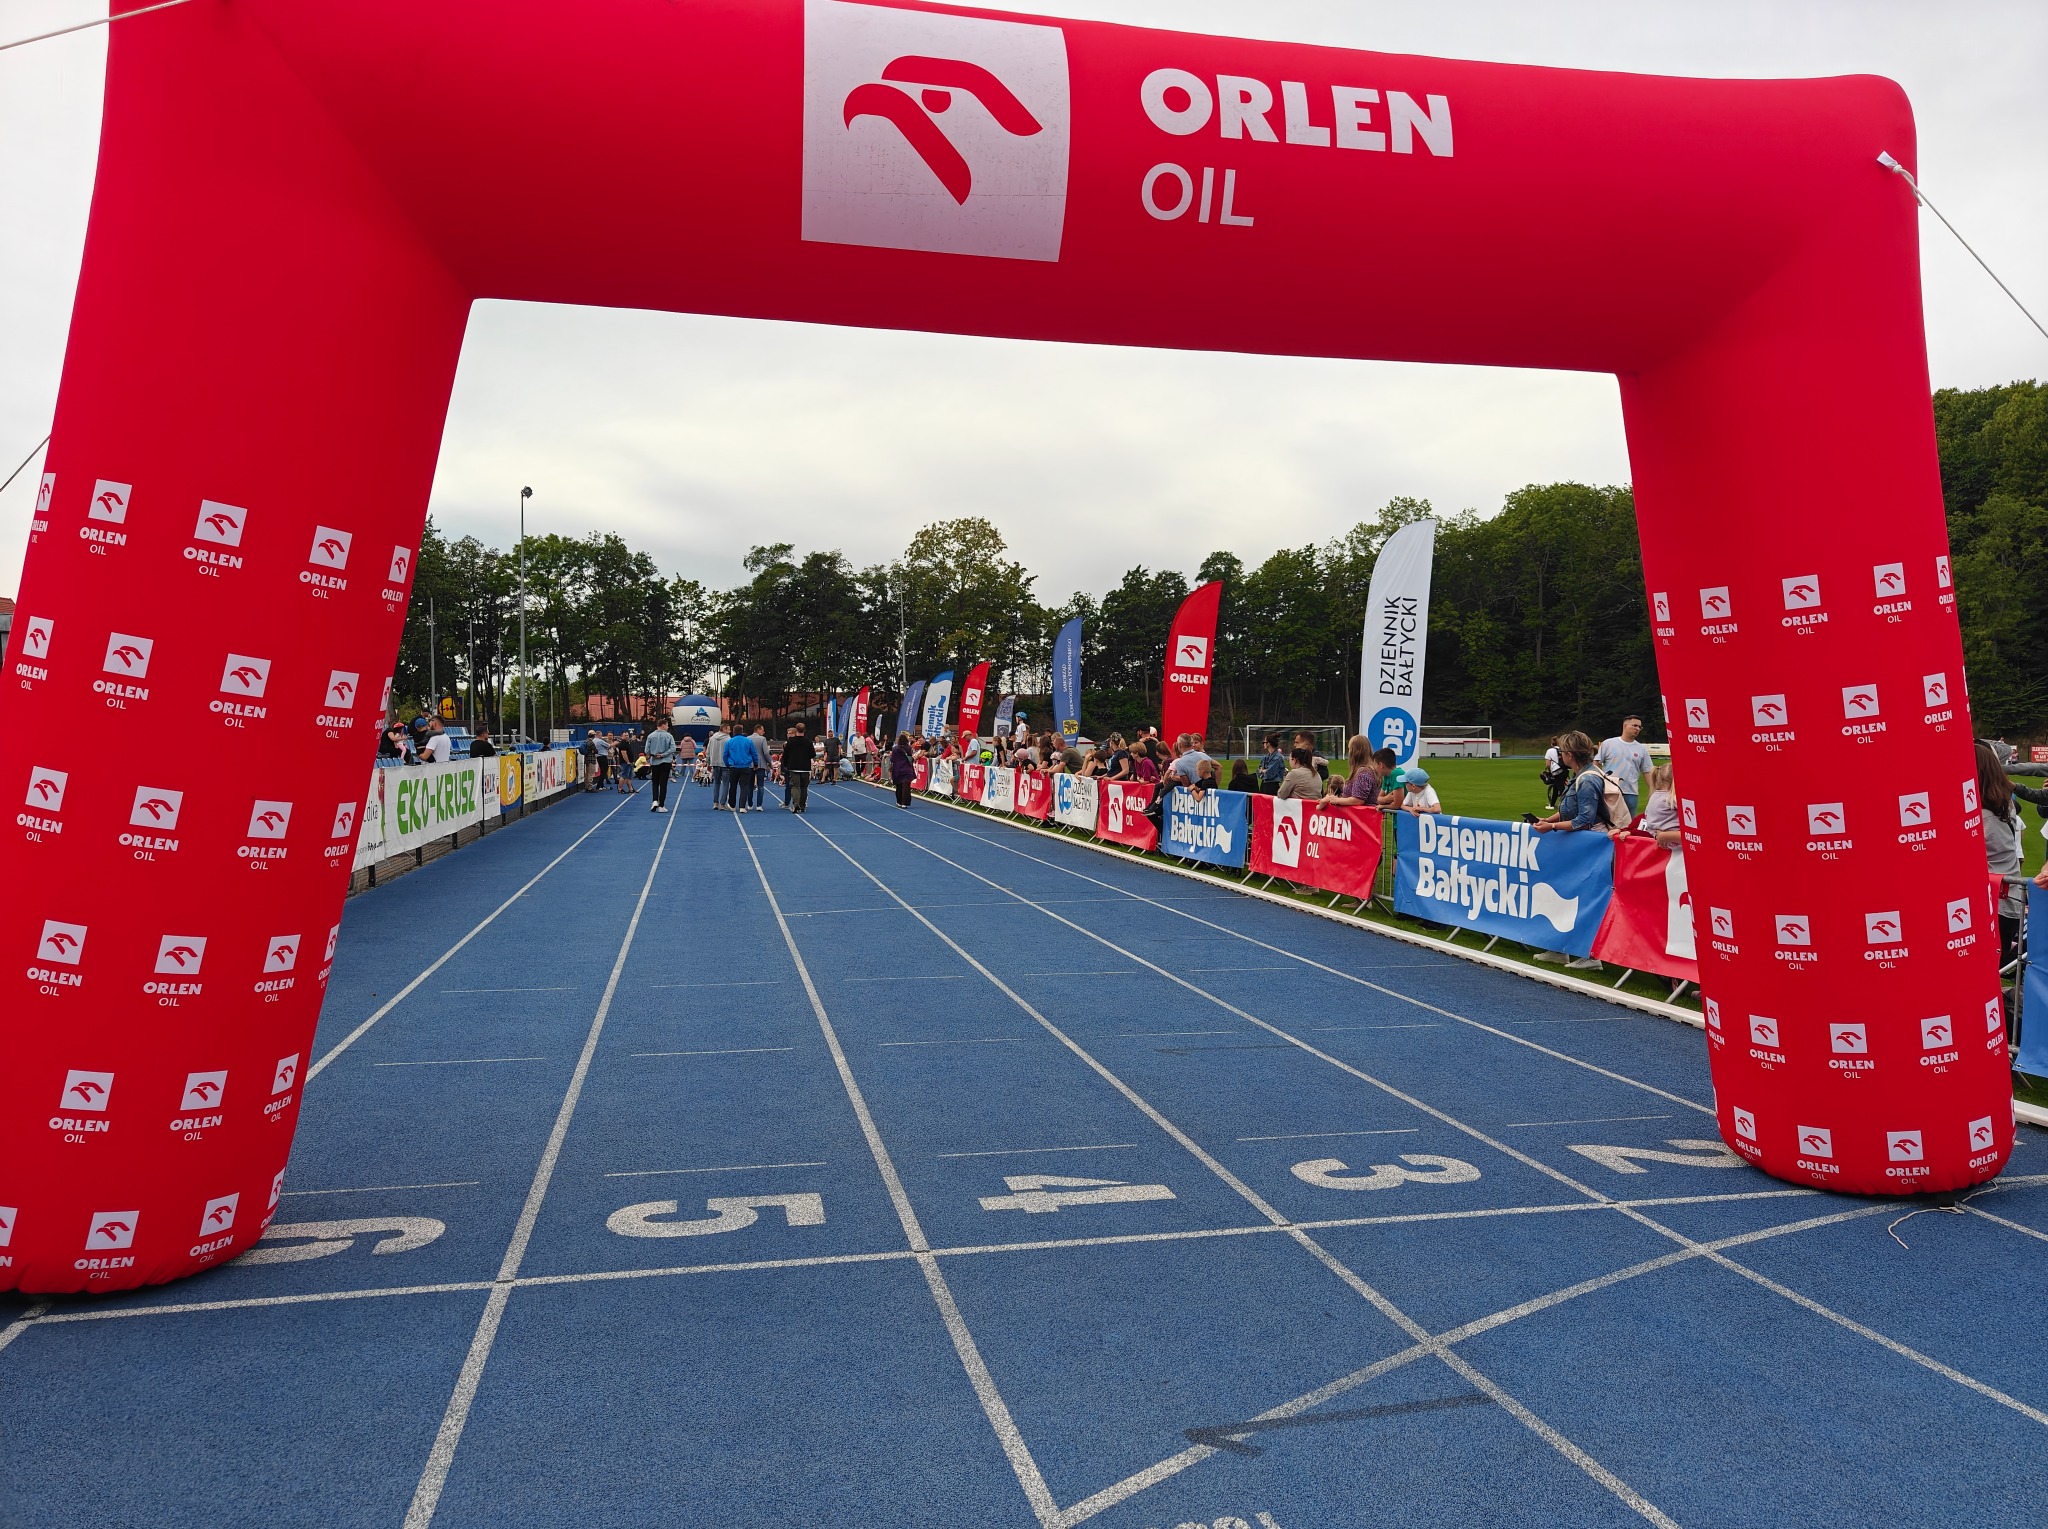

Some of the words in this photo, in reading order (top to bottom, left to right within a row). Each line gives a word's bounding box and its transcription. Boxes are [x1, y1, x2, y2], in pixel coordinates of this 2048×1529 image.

[1140, 68, 1454, 157] ORLEN
[1141, 162, 1255, 227] OIL
[80, 526, 127, 546] ORLEN
[89, 545, 107, 555] OIL
[184, 546, 242, 569] ORLEN
[199, 566, 219, 577] OIL
[300, 570, 347, 590] ORLEN
[311, 589, 329, 599] OIL
[382, 588, 403, 602] ORLEN
[1939, 593, 1954, 604] ORLEN
[1874, 600, 1911, 615] ORLEN
[1782, 612, 1828, 626] ORLEN
[1887, 615, 1902, 623] OIL
[1657, 627, 1674, 636] ORLEN
[1701, 622, 1737, 635] ORLEN
[1797, 627, 1815, 635] OIL
[1379, 596, 1401, 695] DZIENNIK
[1397, 598, 1418, 697] BAŁTYCKI
[16, 662, 47, 680] ORLEN
[1170, 673, 1209, 685] ORLEN
[93, 679, 149, 700] ORLEN
[1181, 685, 1196, 693] OIL
[107, 698, 126, 709] OIL
[210, 700, 266, 718] ORLEN
[225, 718, 244, 728] OIL
[316, 714, 353, 728] ORLEN
[934, 708, 944, 739] ałtycki
[1924, 709, 1952, 724] ORLEN
[325, 730, 340, 738] OIL
[1842, 721, 1886, 735] ORLEN
[1382, 717, 1405, 756] DB
[1688, 733, 1715, 743] ORLEN
[1752, 731, 1795, 742] ORLEN
[1857, 736, 1874, 744] OIL
[397, 769, 476, 835] EKO-KRUSZ
[1126, 796, 1146, 812] ORLEN
[1171, 786, 1220, 818] Dziennik
[17, 813, 62, 833] ORLEN
[1309, 814, 1351, 841] ORLEN
[26, 832, 43, 842] OIL
[1171, 814, 1215, 853] Bałtycki
[1685, 831, 1701, 844] ORLEN
[1898, 828, 1936, 843] ORLEN
[119, 832, 179, 851] ORLEN
[1418, 813, 1540, 871] Dziennik
[1727, 840, 1762, 851] ORLEN
[1806, 839, 1852, 851] ORLEN
[134, 851, 155, 861] OIL
[237, 845, 287, 858] ORLEN
[325, 843, 349, 857] ORLEN
[1306, 841, 1320, 858] OIL
[251, 861, 268, 869] OIL
[1415, 857, 1529, 921] Bałtycki
[1712, 940, 1738, 954] ORLEN
[1947, 933, 1975, 950] ORLEN
[1775, 950, 1817, 961] ORLEN
[1864, 947, 1908, 960] ORLEN
[27, 967, 82, 986] ORLEN
[40, 986, 59, 996] OIL
[143, 981, 202, 994] ORLEN
[254, 977, 294, 992] ORLEN
[159, 998, 179, 1006] OIL
[264, 994, 279, 1002] OIL
[1750, 1048, 1785, 1063] ORLEN
[1920, 1051, 1958, 1066] ORLEN
[1760, 1062, 1775, 1070] OIL
[1829, 1059, 1874, 1069] ORLEN
[264, 1094, 292, 1114] ORLEN
[49, 1116, 109, 1132] ORLEN
[170, 1114, 222, 1130] ORLEN
[64, 1134, 85, 1143] OIL
[184, 1132, 202, 1141] OIL
[1735, 1139, 1762, 1157] ORLEN
[1797, 1159, 1839, 1173] ORLEN
[1968, 1151, 1998, 1169] ORLEN
[1291, 1154, 1482, 1191] 3
[1886, 1166, 1929, 1176] ORLEN
[979, 1174, 1177, 1213] 4
[606, 1192, 826, 1238] 5
[190, 1234, 233, 1255] ORLEN
[75, 1256, 134, 1269] ORLEN
[89, 1271, 110, 1279] OIL
